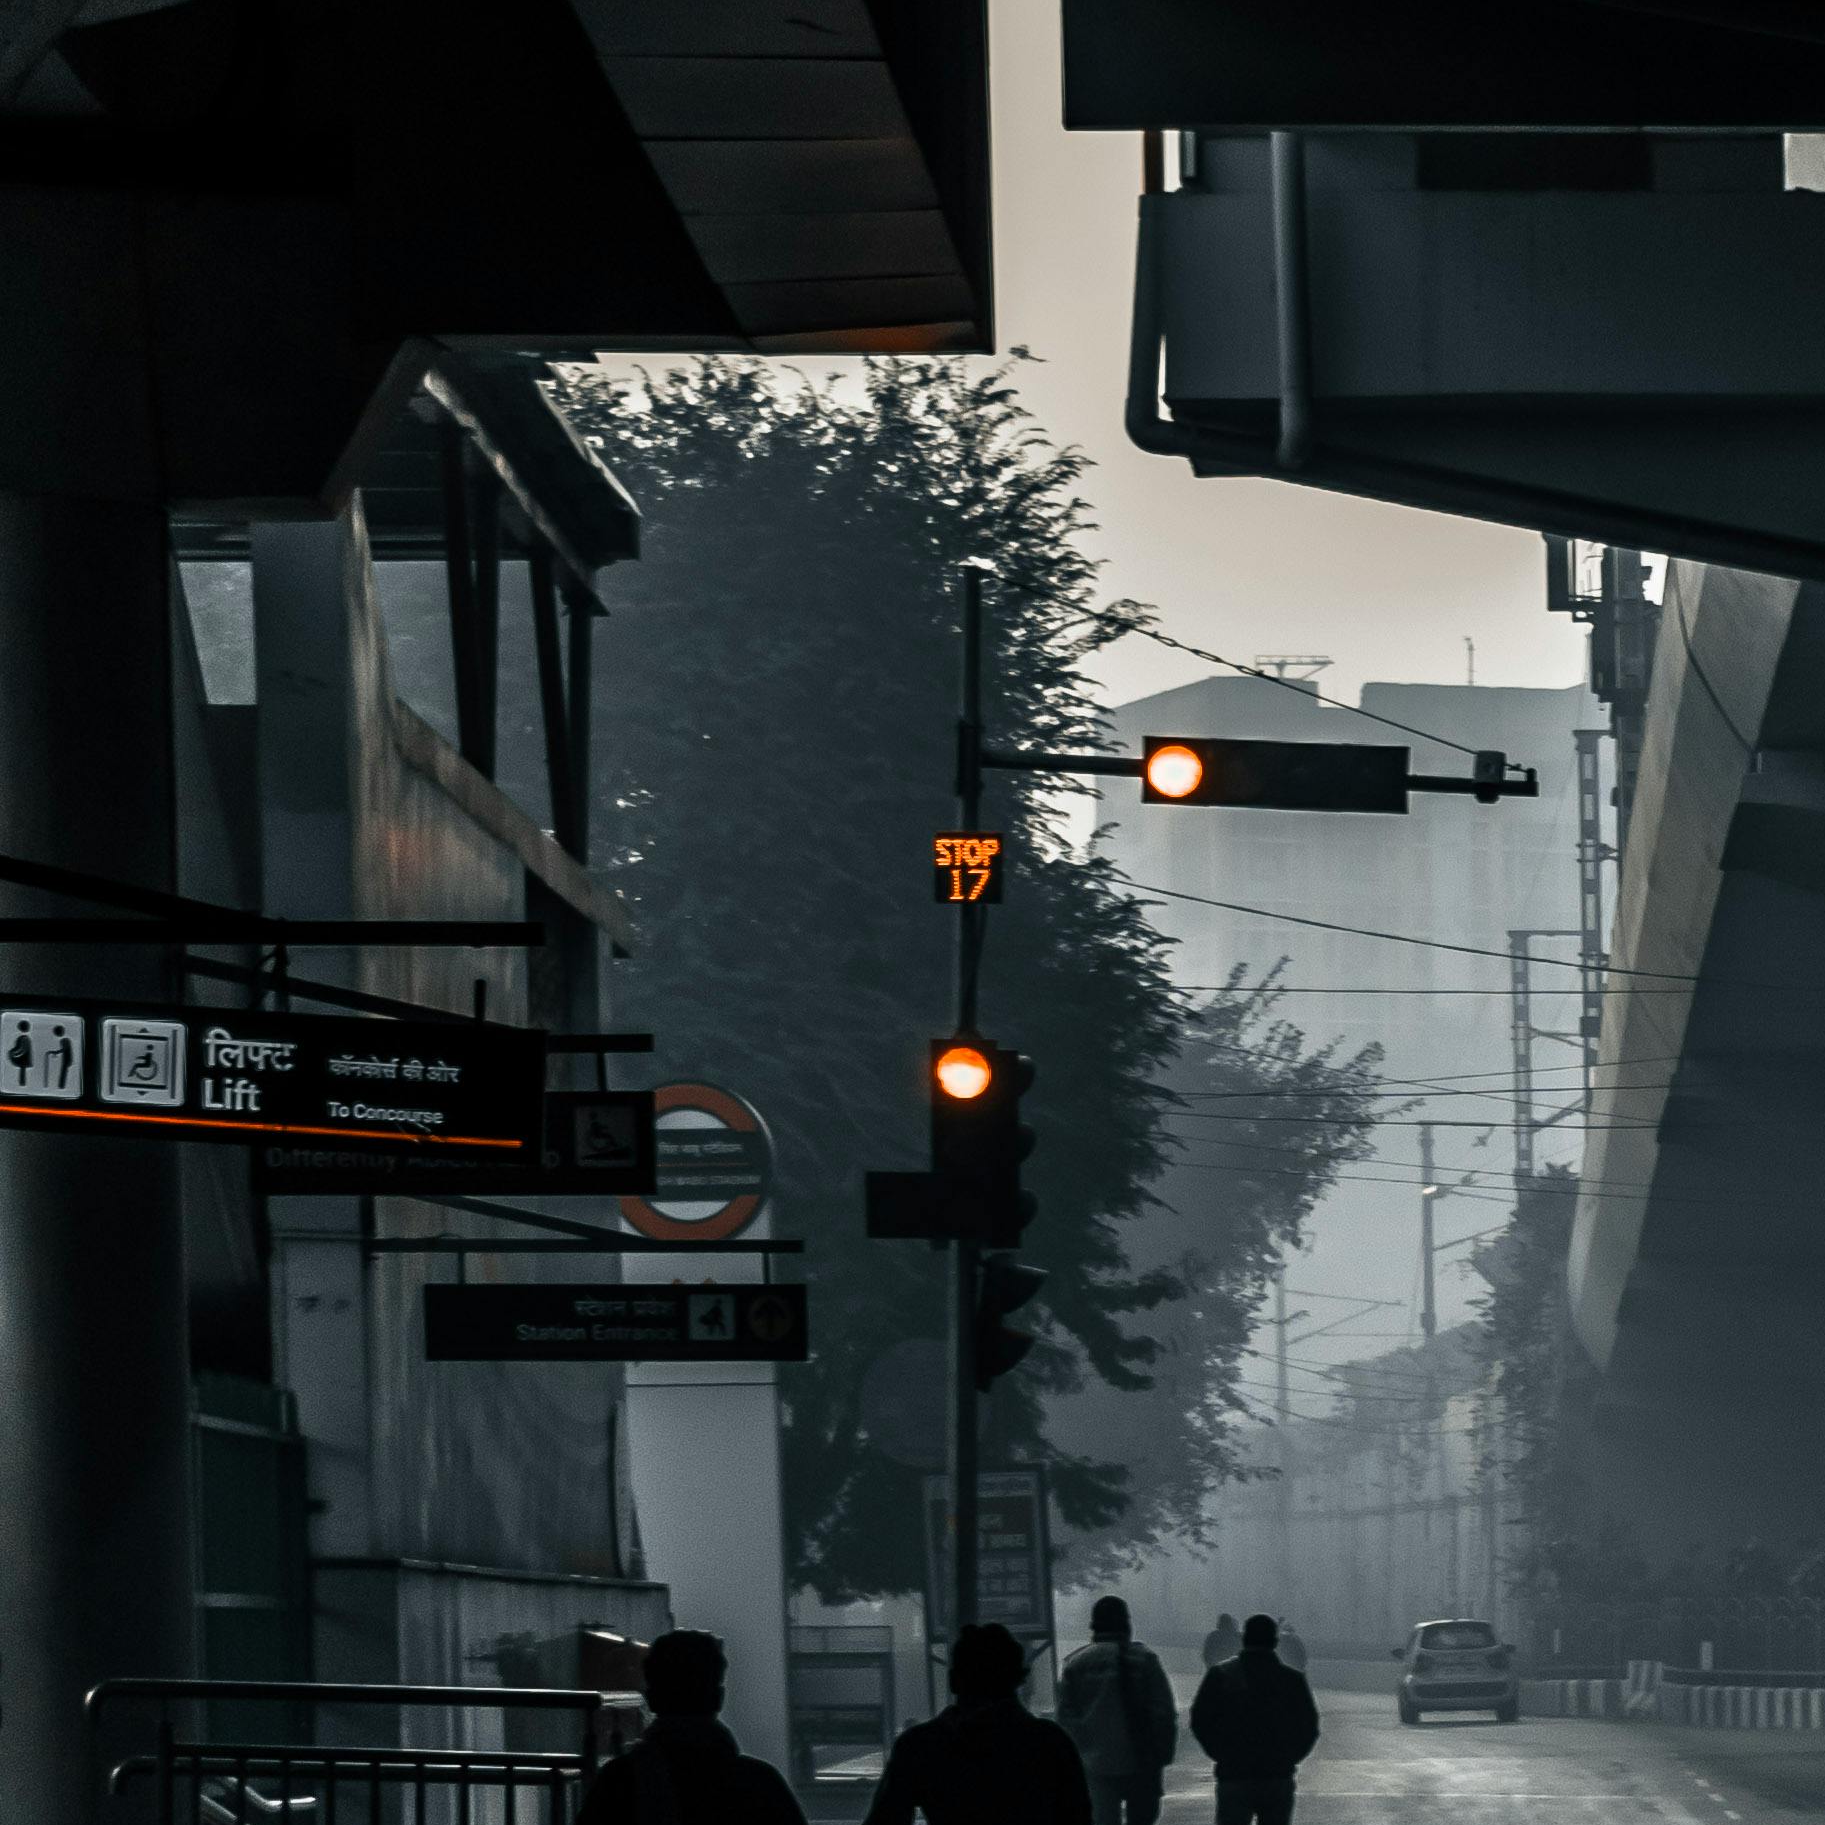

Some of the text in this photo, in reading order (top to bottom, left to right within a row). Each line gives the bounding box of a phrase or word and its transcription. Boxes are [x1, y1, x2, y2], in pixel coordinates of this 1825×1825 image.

[935, 839, 1001, 866] STOP
[949, 869, 991, 900] 17
[203, 1027, 297, 1071] लिफ्ट
[328, 1054, 462, 1083] कॉनकोर्स की ओर
[202, 1077, 262, 1112] Lift
[327, 1101, 443, 1125] To Concourse
[516, 1323, 587, 1341] Station
